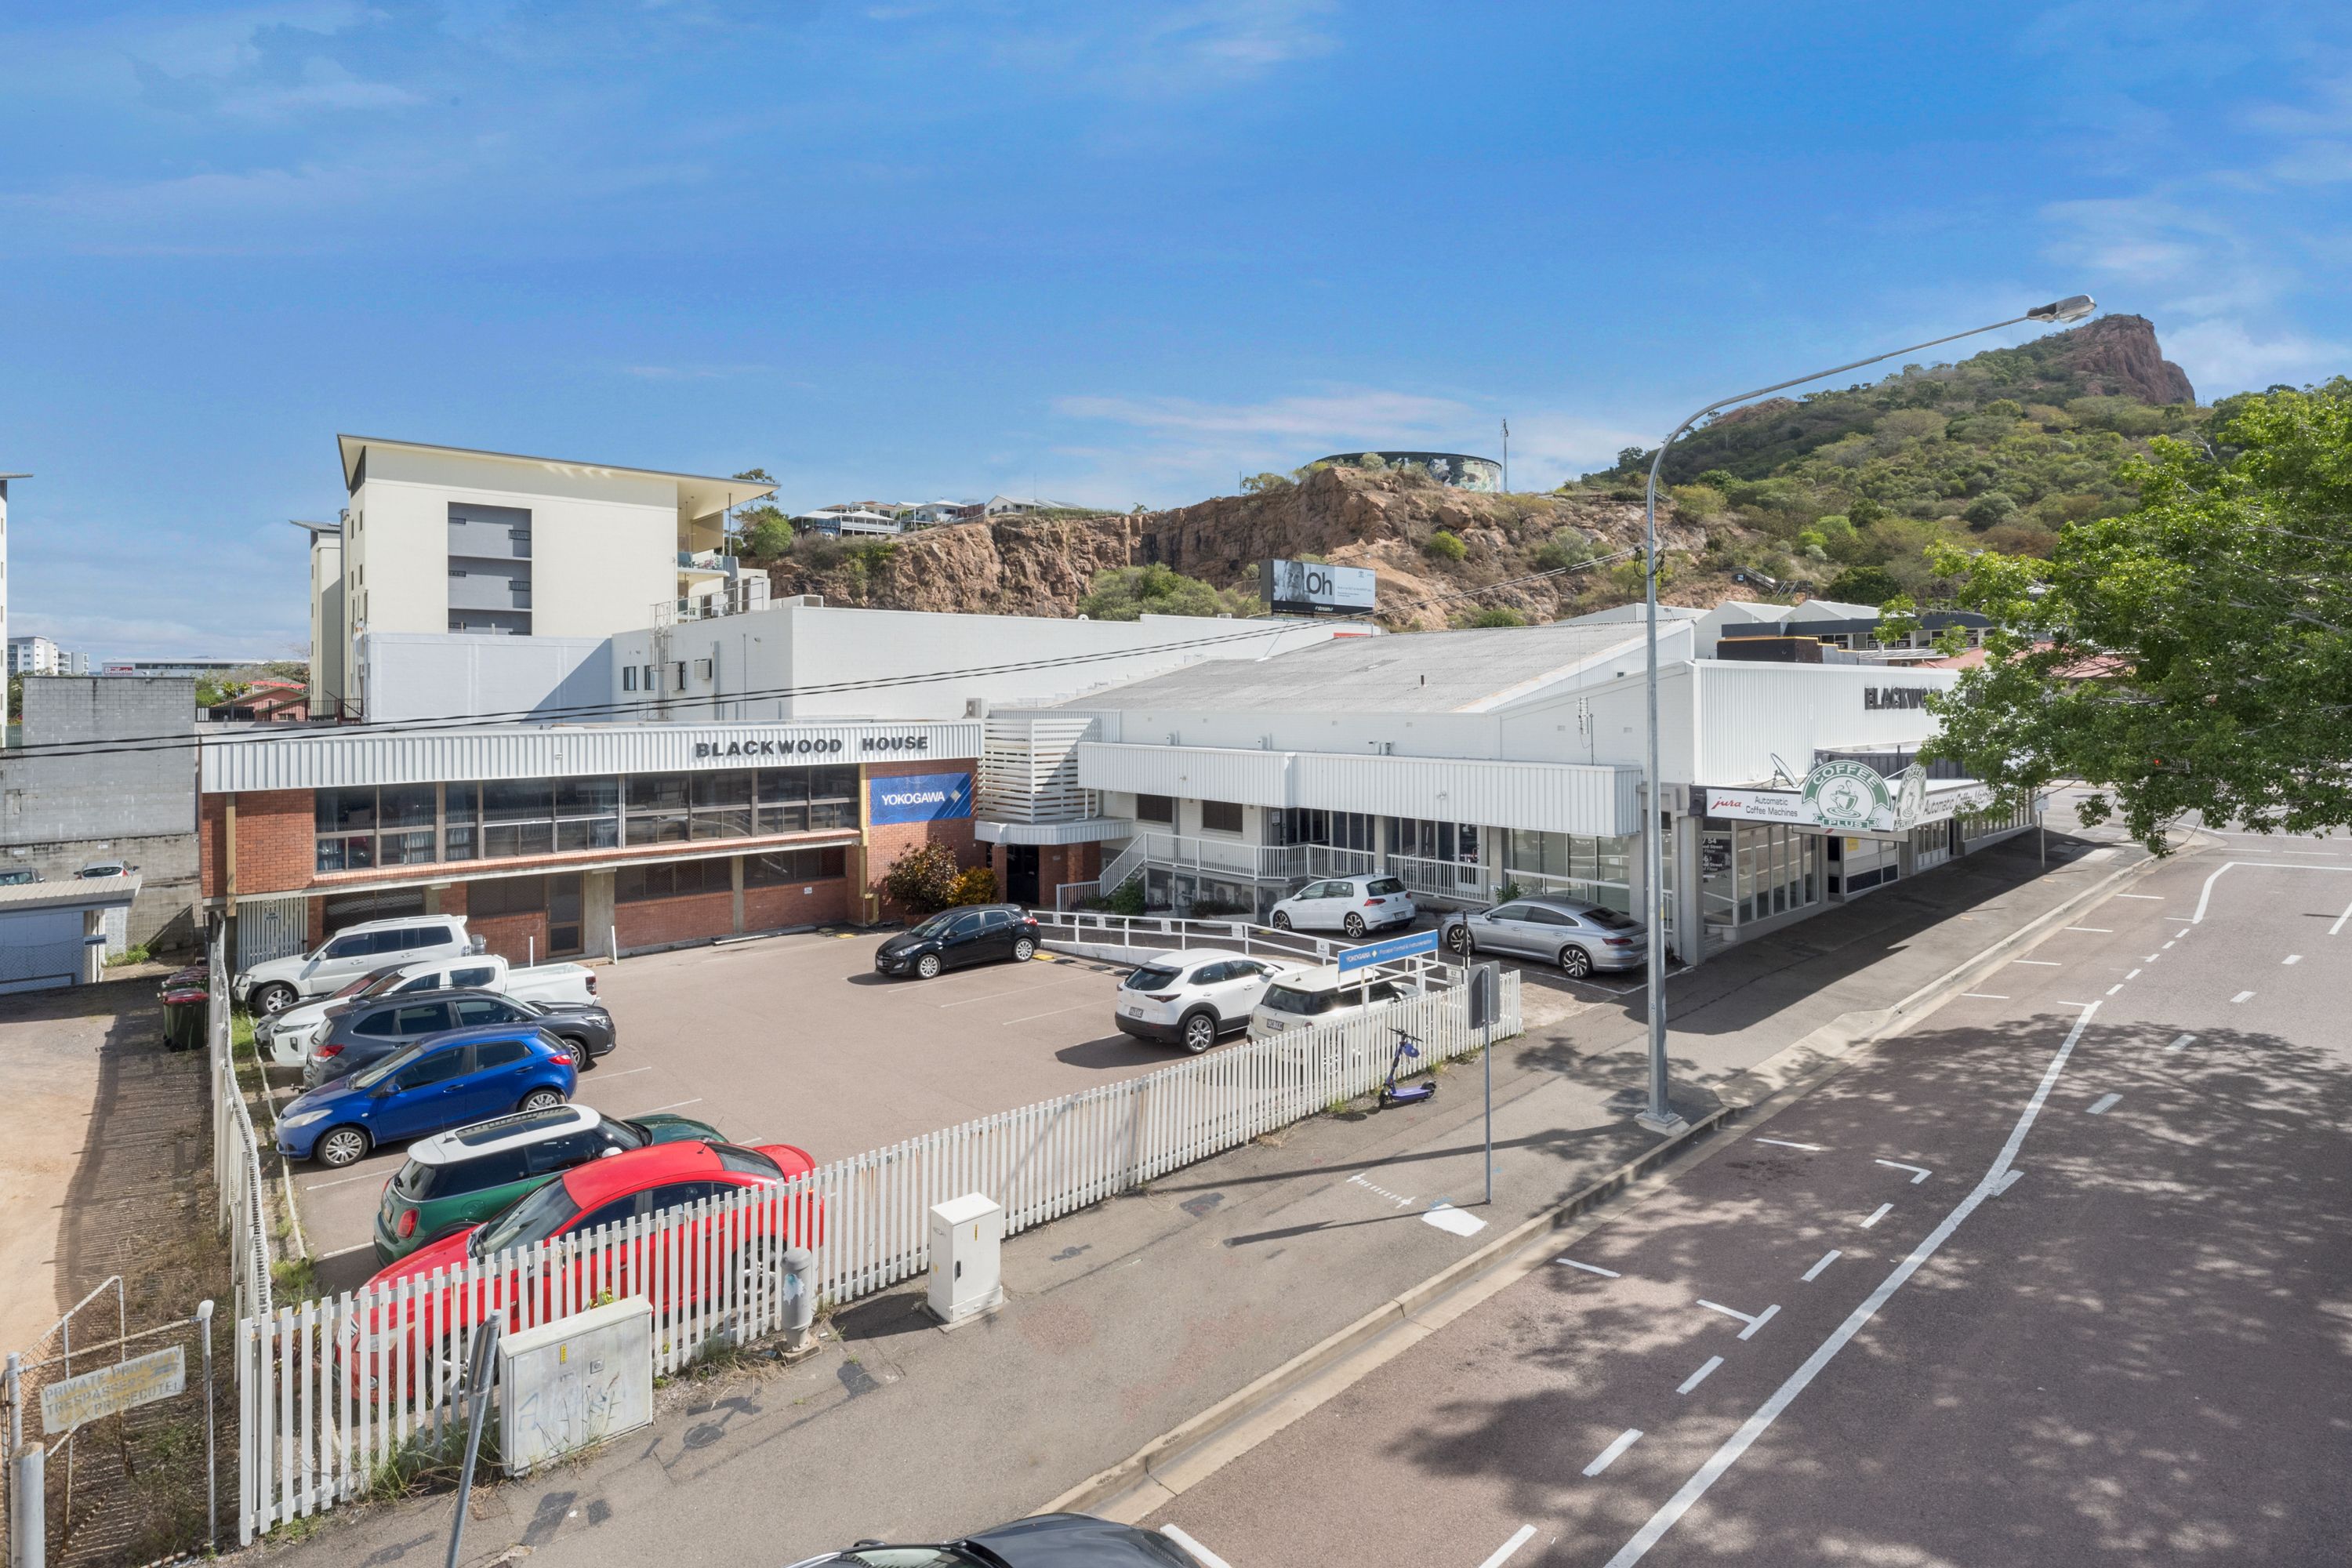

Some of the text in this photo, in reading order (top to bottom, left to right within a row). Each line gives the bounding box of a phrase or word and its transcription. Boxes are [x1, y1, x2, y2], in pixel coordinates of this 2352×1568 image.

[1306, 572, 1333, 595] Oh
[1864, 687, 1944, 710] BLACKWO
[695, 736, 928, 758] BLACKWOOD HOUSE
[1813, 764, 1879, 789] COFFEE
[881, 791, 946, 806] YOKOGAWA
[1711, 797, 1742, 810] jura
[1755, 796, 1788, 806] Automatic
[1923, 796, 1955, 815] Automatic
[1746, 805, 1798, 817] Coffee Machines
[1346, 952, 1371, 963] YOKOGAWA
[45, 1372, 105, 1402] PRIVATE
[45, 1375, 146, 1416] TRESPASSERS
